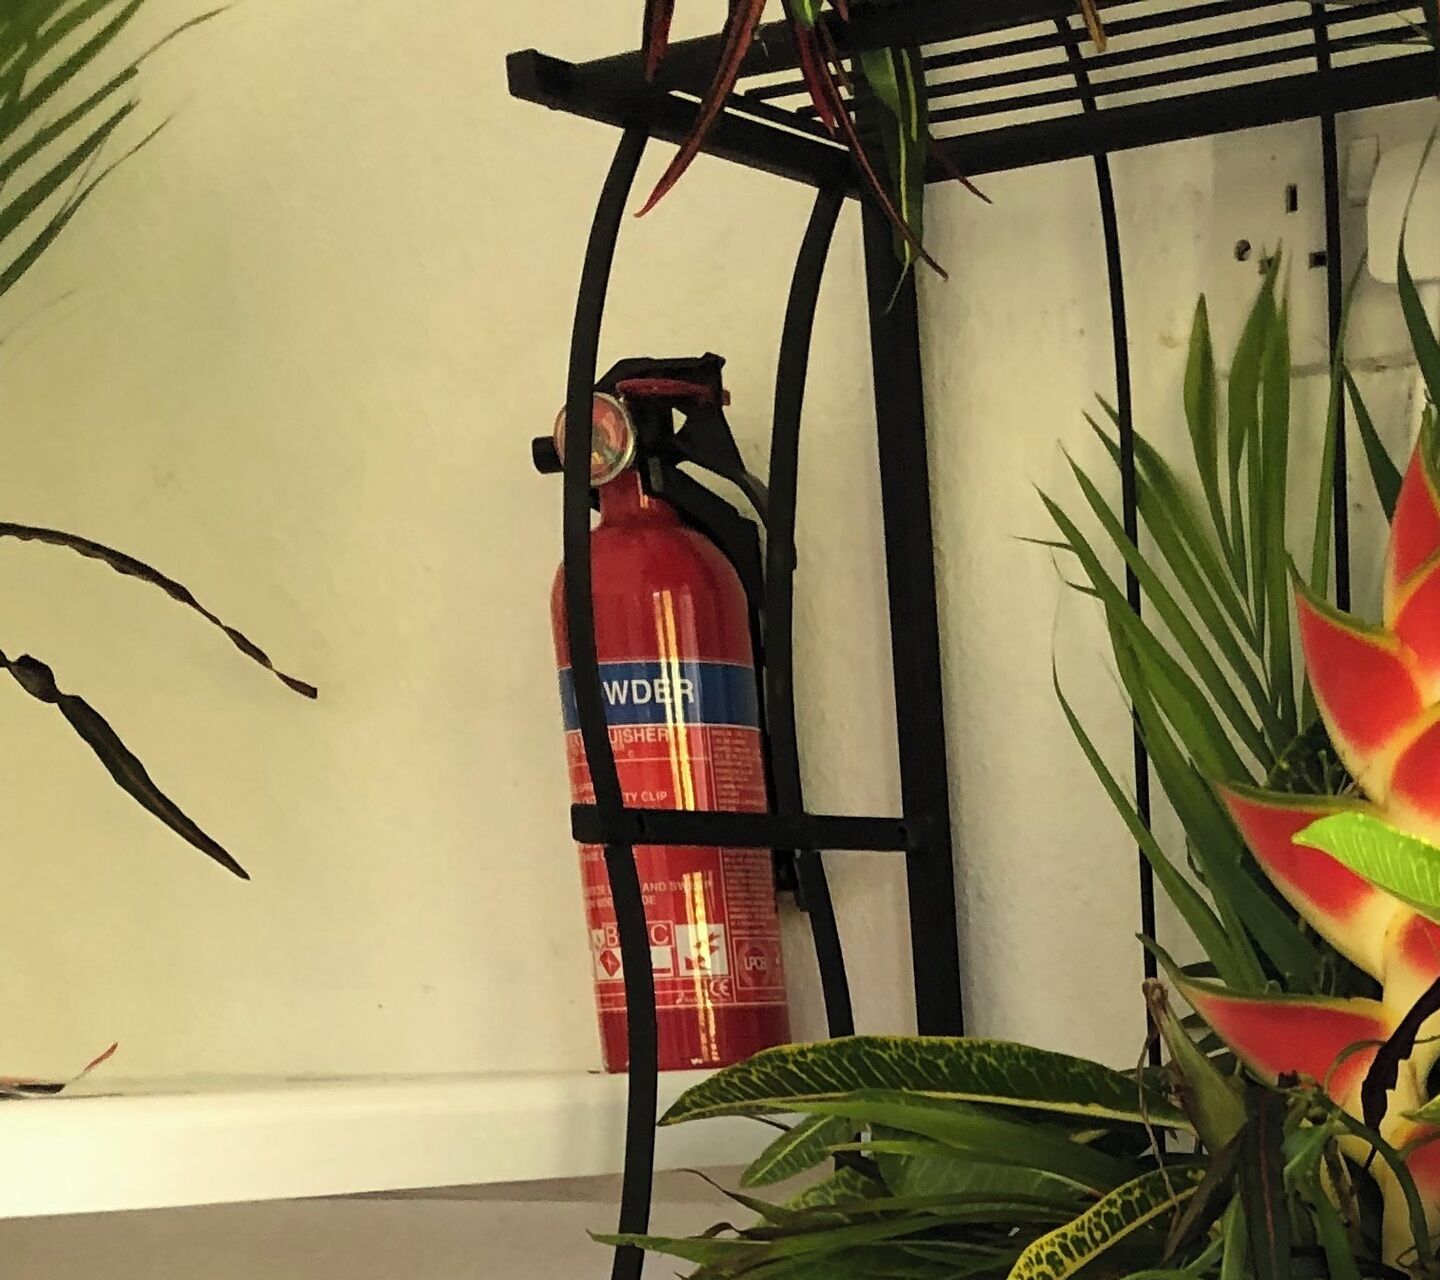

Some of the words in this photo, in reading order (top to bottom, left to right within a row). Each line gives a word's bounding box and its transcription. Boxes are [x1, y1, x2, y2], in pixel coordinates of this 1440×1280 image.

[603, 678, 695, 706] WDER
[609, 728, 671, 746] UISHER
[624, 791, 638, 803] TY
[640, 790, 668, 802] CLIP
[642, 881, 667, 893] AND
[650, 923, 669, 946] C
